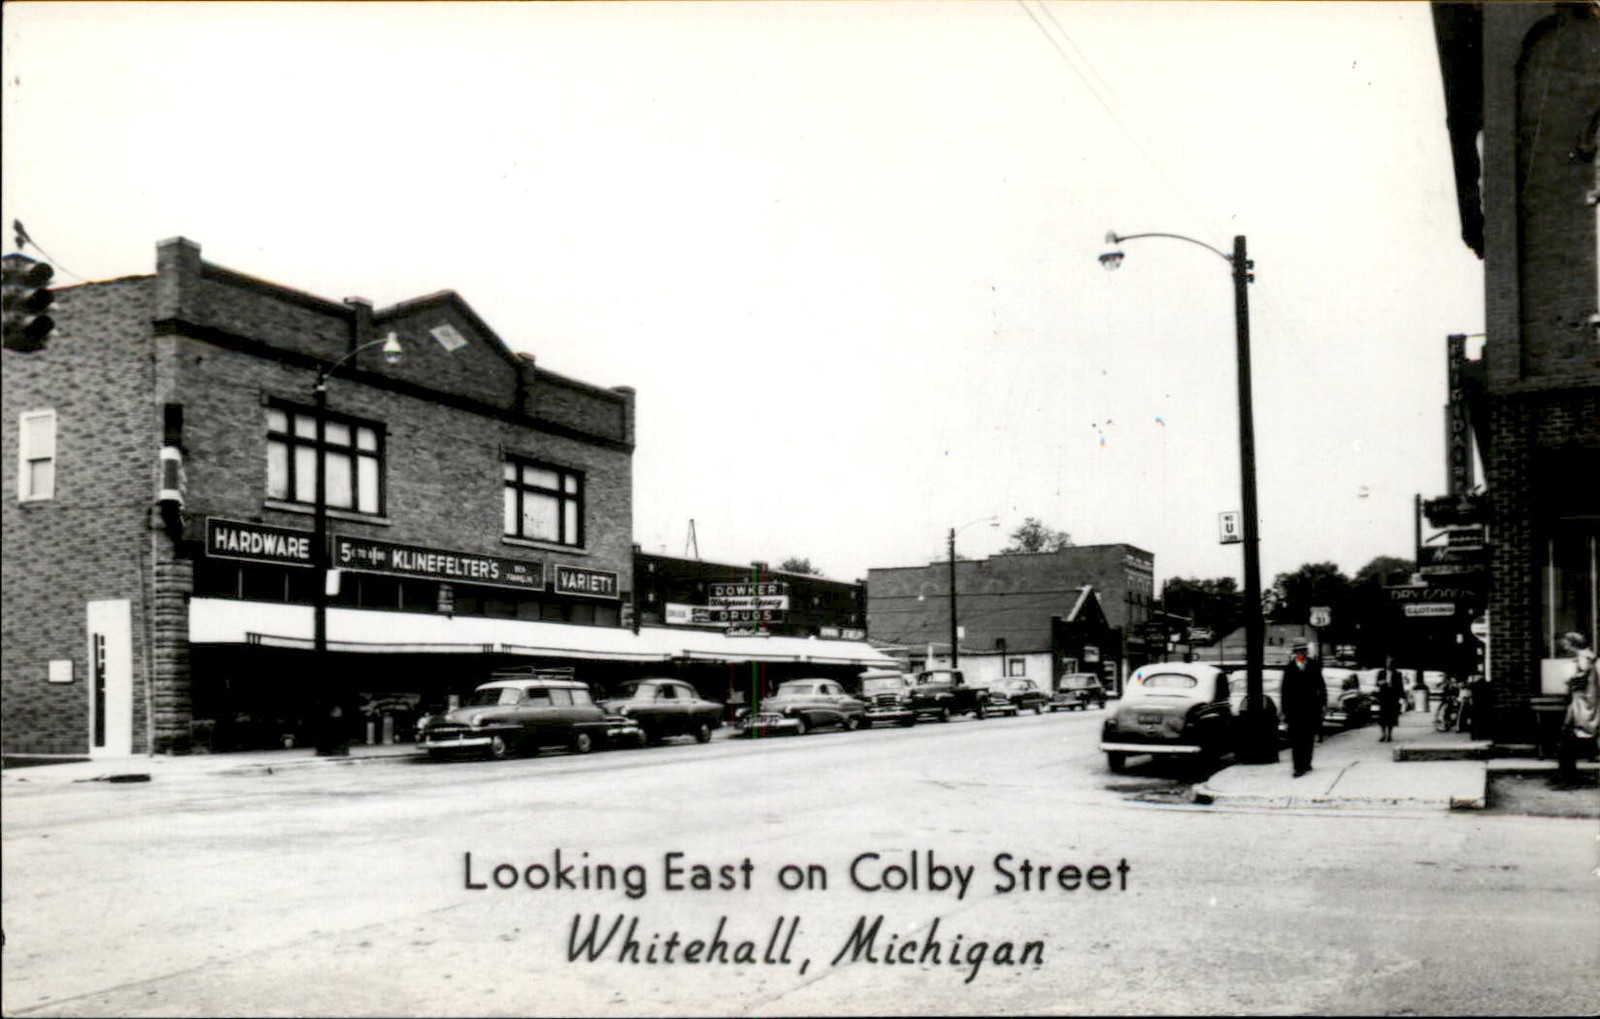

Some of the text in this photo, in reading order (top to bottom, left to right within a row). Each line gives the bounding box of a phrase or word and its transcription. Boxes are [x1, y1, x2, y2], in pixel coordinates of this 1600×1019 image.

[1226, 523, 1234, 533] U
[215, 527, 310, 559] HARDWARE
[392, 549, 500, 579] KLINEFELTER'S
[561, 571, 614, 593] VARIETY
[714, 585, 778, 596] DOWKER
[1405, 605, 1454, 614] CLOTHING
[719, 610, 773, 621] DRUGS
